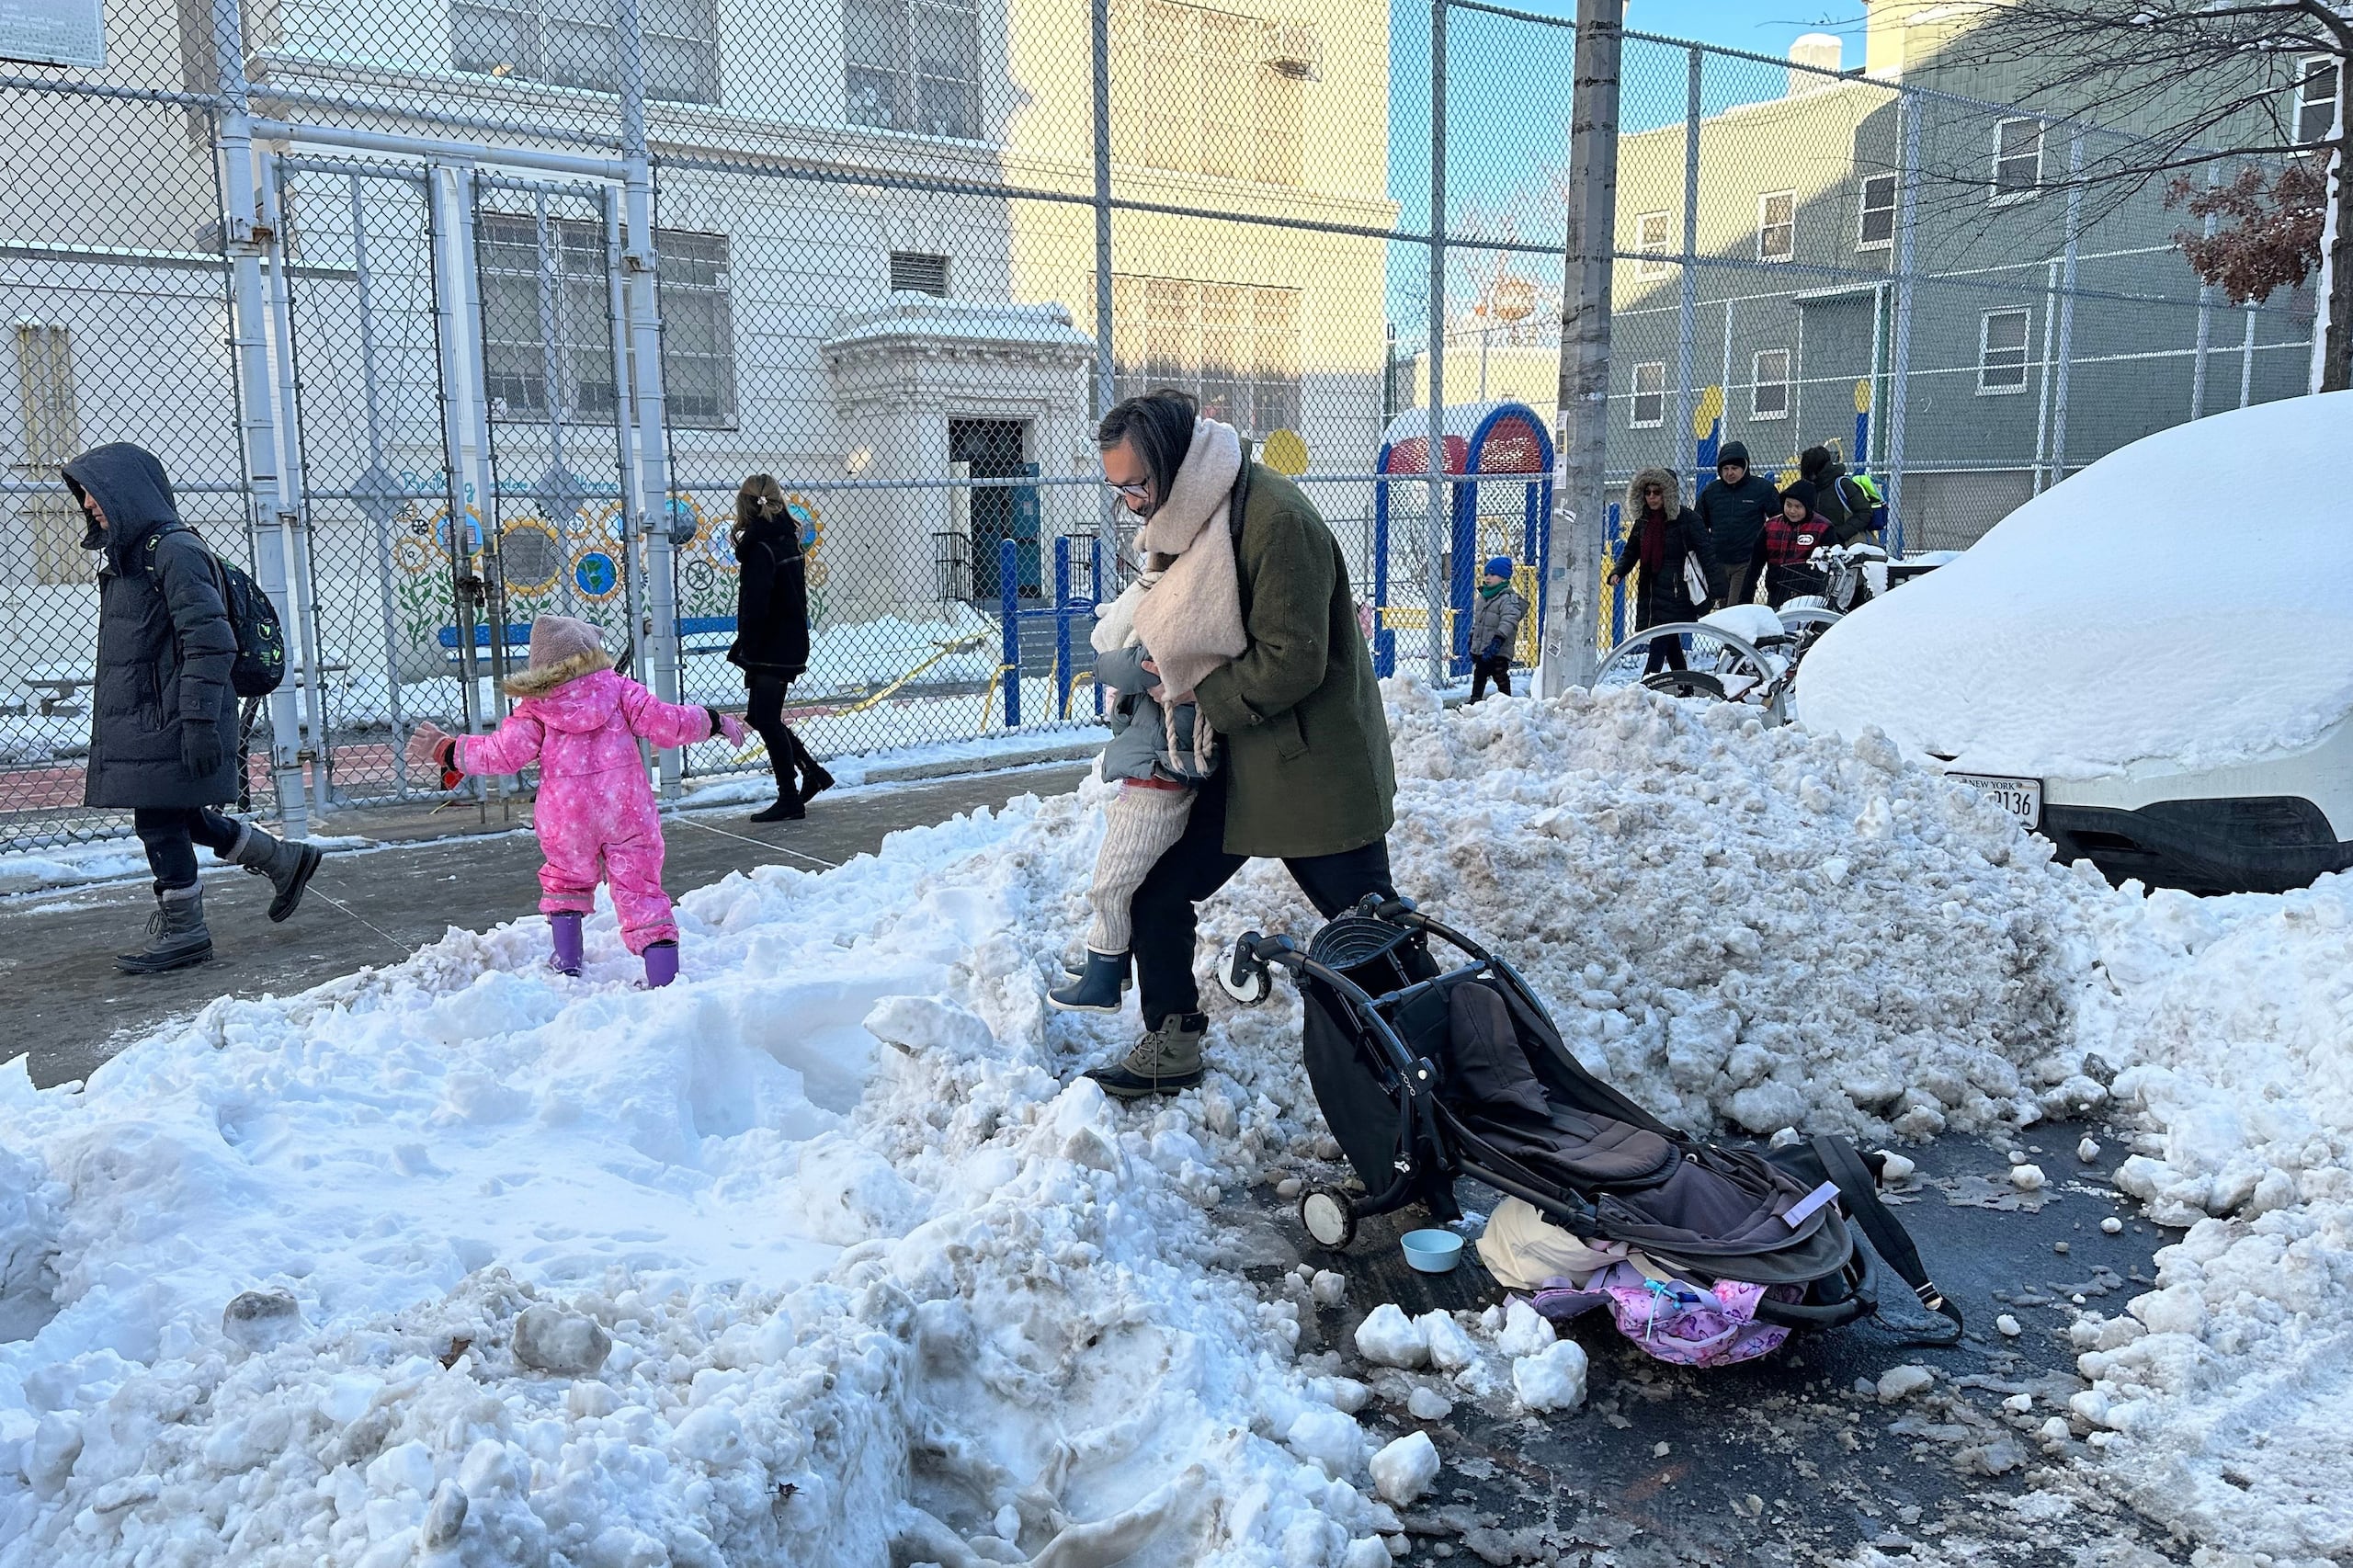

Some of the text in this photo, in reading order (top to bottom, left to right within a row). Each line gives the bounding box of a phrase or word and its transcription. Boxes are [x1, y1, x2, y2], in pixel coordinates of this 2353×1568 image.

[1969, 779, 2016, 790] NEW YORK
[1400, 1069, 1416, 1096] YOYO
